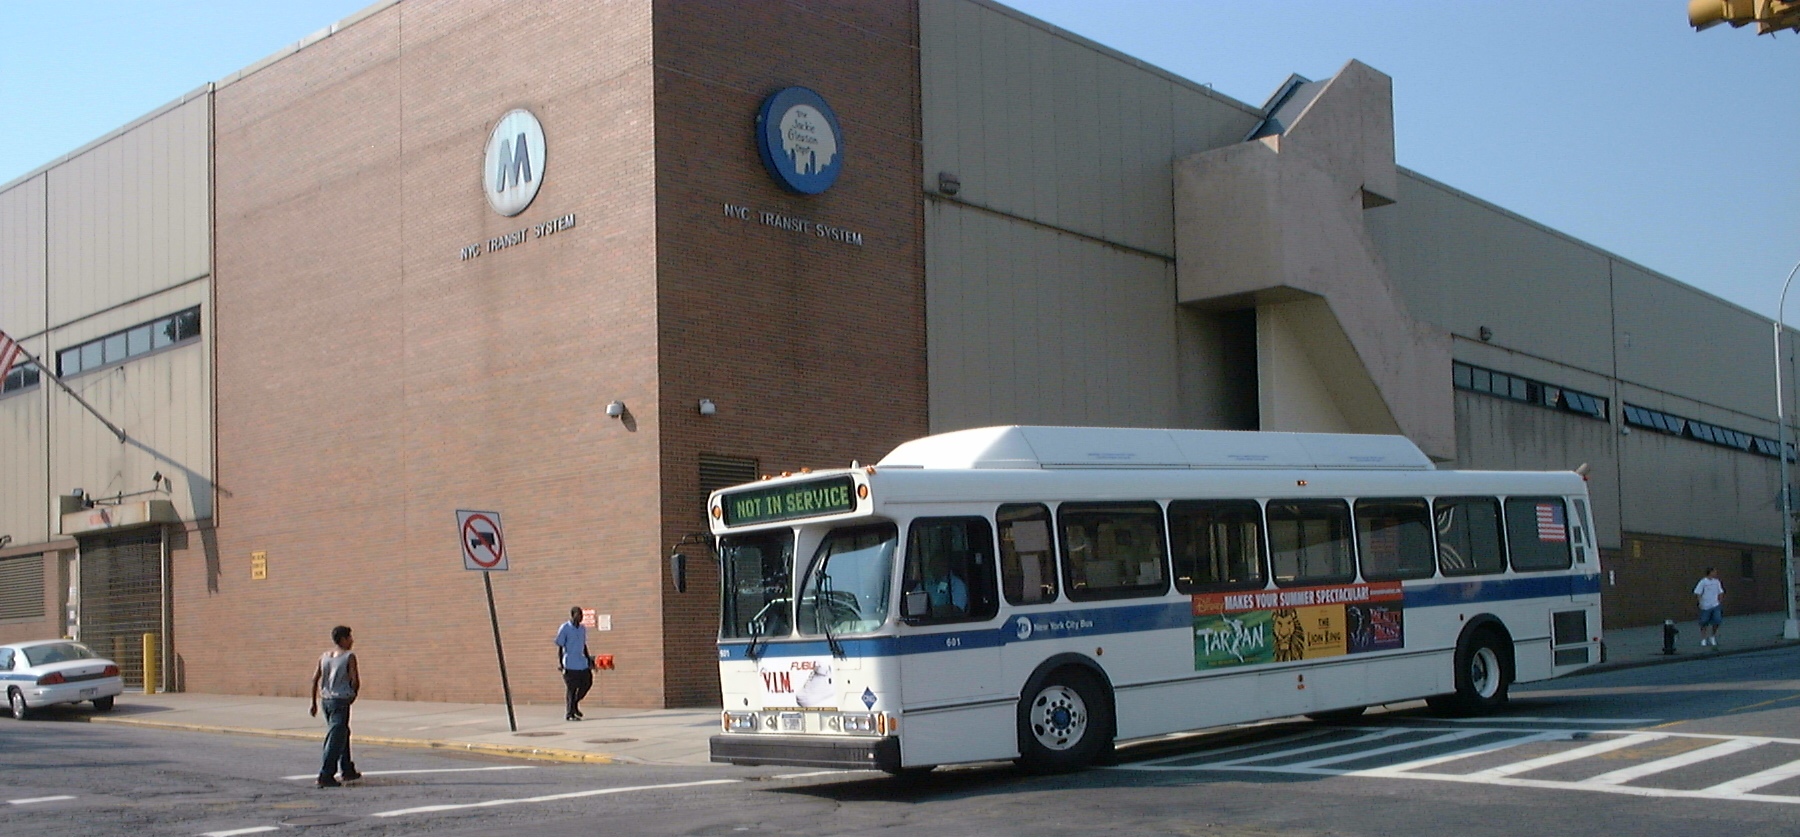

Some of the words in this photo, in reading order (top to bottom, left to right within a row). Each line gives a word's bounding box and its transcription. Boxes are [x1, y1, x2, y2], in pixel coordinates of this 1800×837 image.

[787, 129, 818, 145] Gleason
[792, 119, 815, 133] Jackie
[496, 132, 532, 194] M
[460, 243, 481, 261] NYC
[486, 228, 529, 253] TRANSIT
[533, 213, 576, 238] SYSTEM
[723, 203, 750, 220] NYC
[758, 210, 810, 234] TRANSIT
[815, 223, 863, 246] SYSTEM
[736, 498, 761, 519] NOT
[767, 496, 781, 515] IN
[786, 485, 849, 512] SERVICE
[1224, 594, 1254, 611] MAKES
[1255, 592, 1279, 609] YOUR
[1279, 588, 1315, 607] SUMMER
[1316, 586, 1369, 605] SPECTACULAR!
[1049, 620, 1064, 630] York
[1065, 619, 1079, 631] City
[1080, 618, 1094, 628] Bus
[1318, 617, 1329, 627] THE
[945, 638, 961, 648] 601
[1196, 621, 1264, 657] TARZAN
